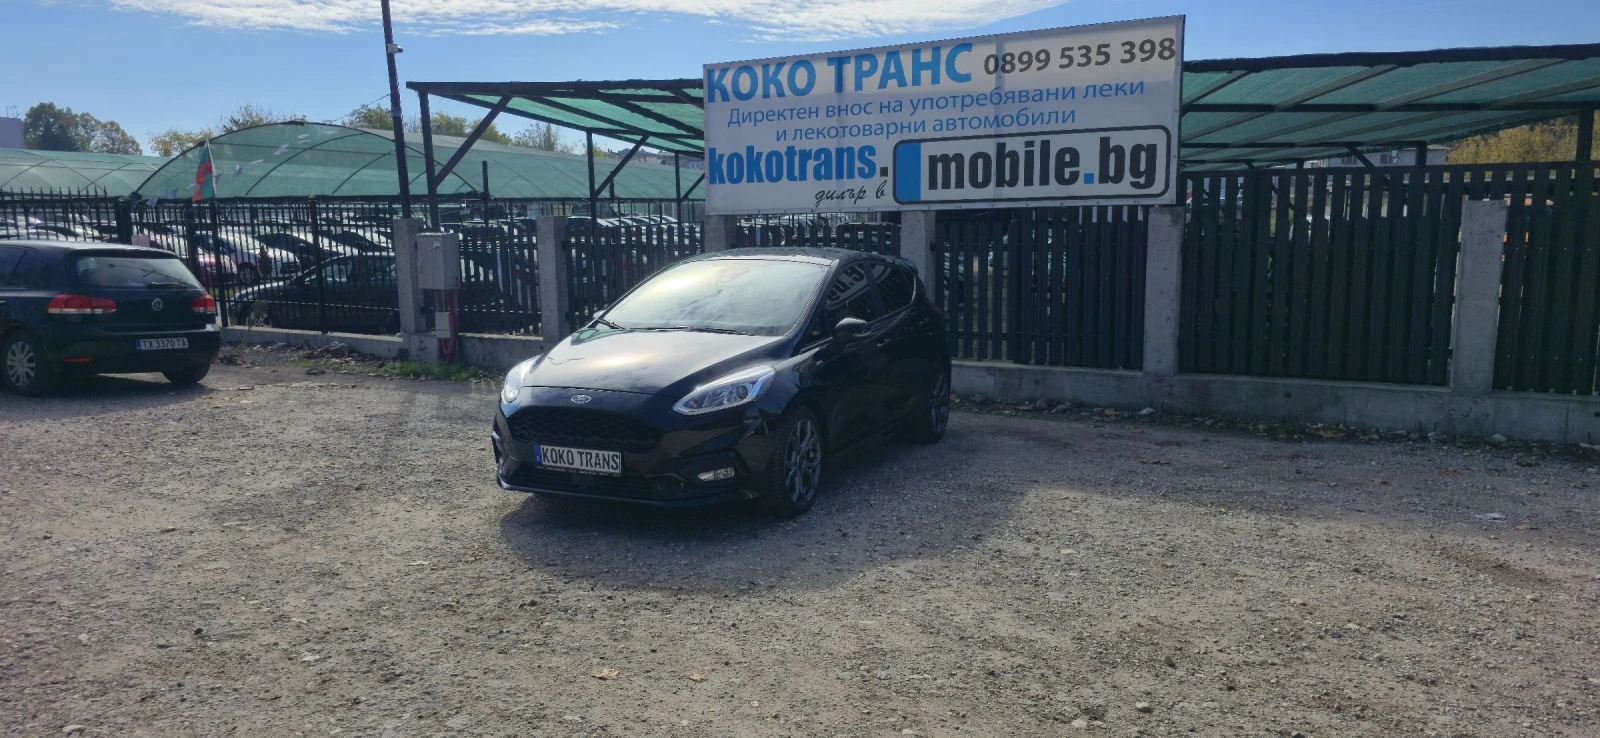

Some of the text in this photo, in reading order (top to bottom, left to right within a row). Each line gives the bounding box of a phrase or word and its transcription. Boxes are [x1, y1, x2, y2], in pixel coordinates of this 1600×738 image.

[707, 37, 1176, 103] КОКО ТРАНС 0899 535 398
[728, 80, 1145, 128] Директен внос на употребявани леки
[776, 107, 1076, 141] и лекотоварни автомобили
[928, 136, 1158, 190] mobile.bg
[815, 179, 887, 209] дилър в
[155, 339, 176, 349] 3370
[542, 447, 620, 470] KOKO TRANS
